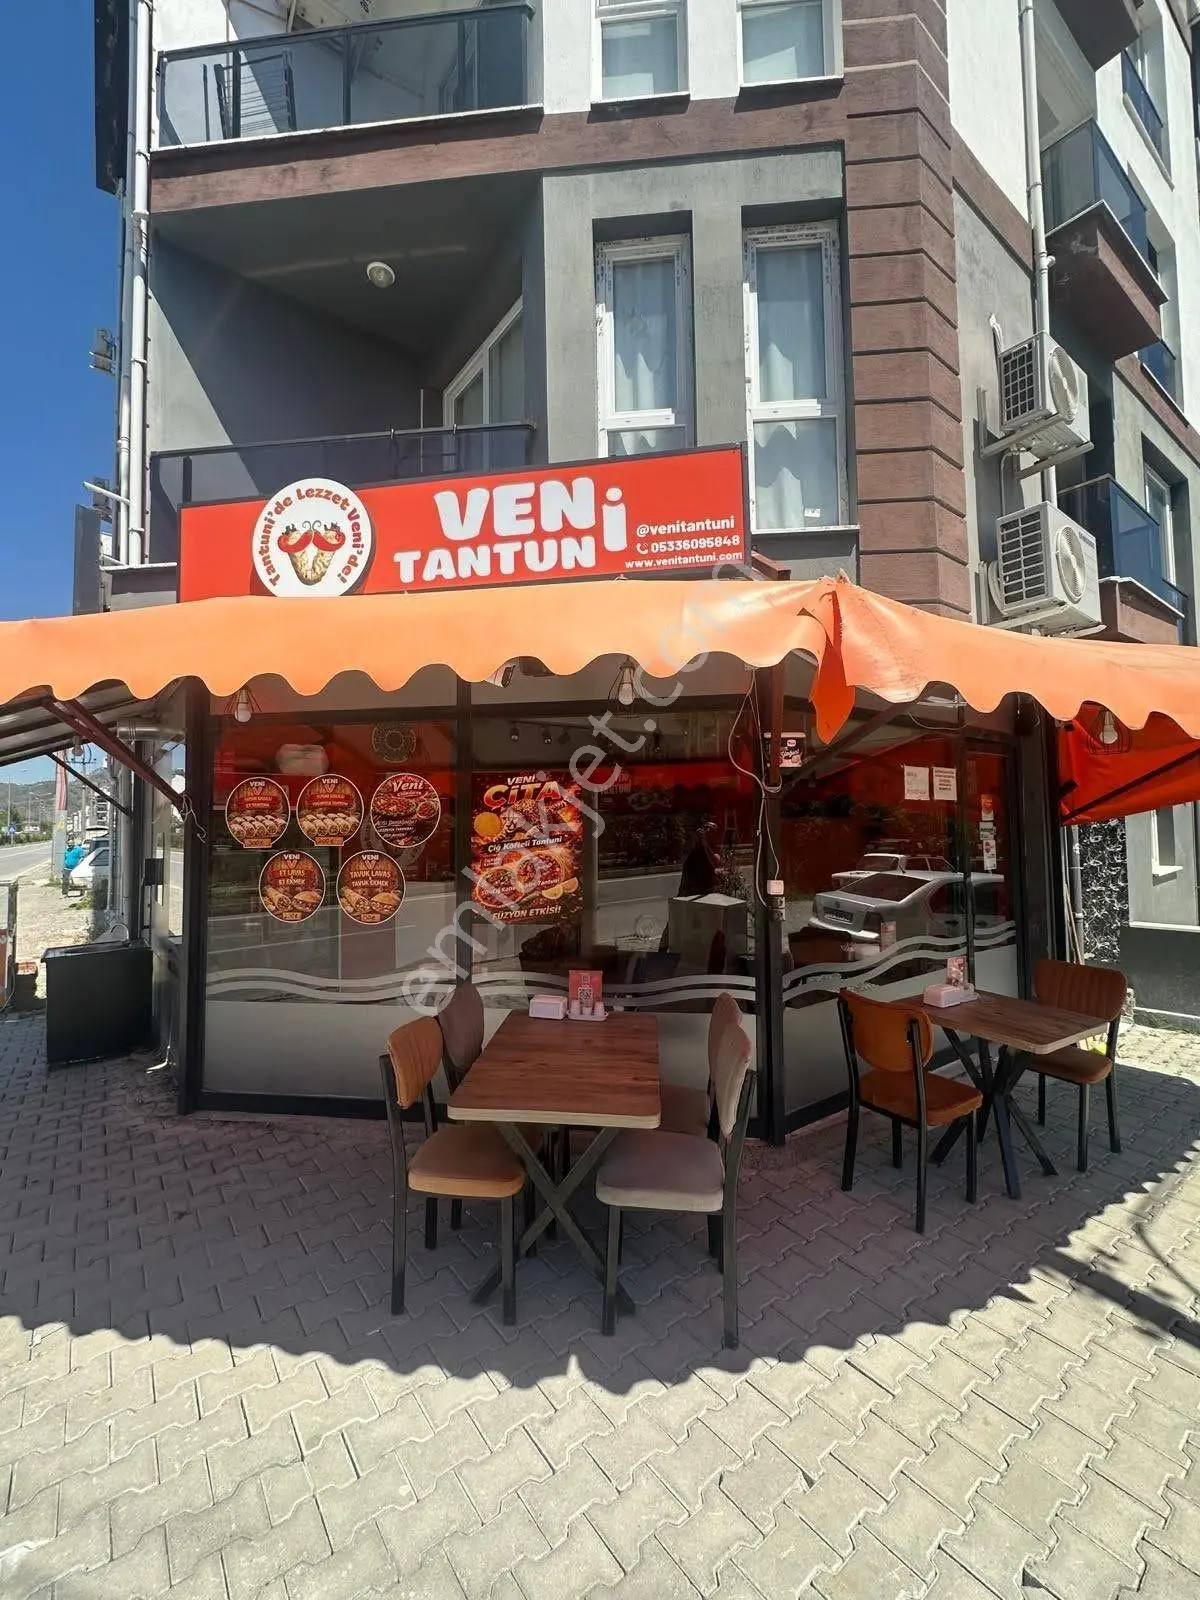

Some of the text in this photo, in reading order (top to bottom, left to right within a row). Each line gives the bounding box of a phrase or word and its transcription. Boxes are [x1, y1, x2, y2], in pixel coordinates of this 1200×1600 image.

[296, 488, 350, 511] Lezzet
[636, 515, 735, 538] @venitantuni
[651, 534, 740, 553] 05336095848
[624, 551, 743, 569] www.venitantuni.com
[392, 780, 424, 792] Veni
